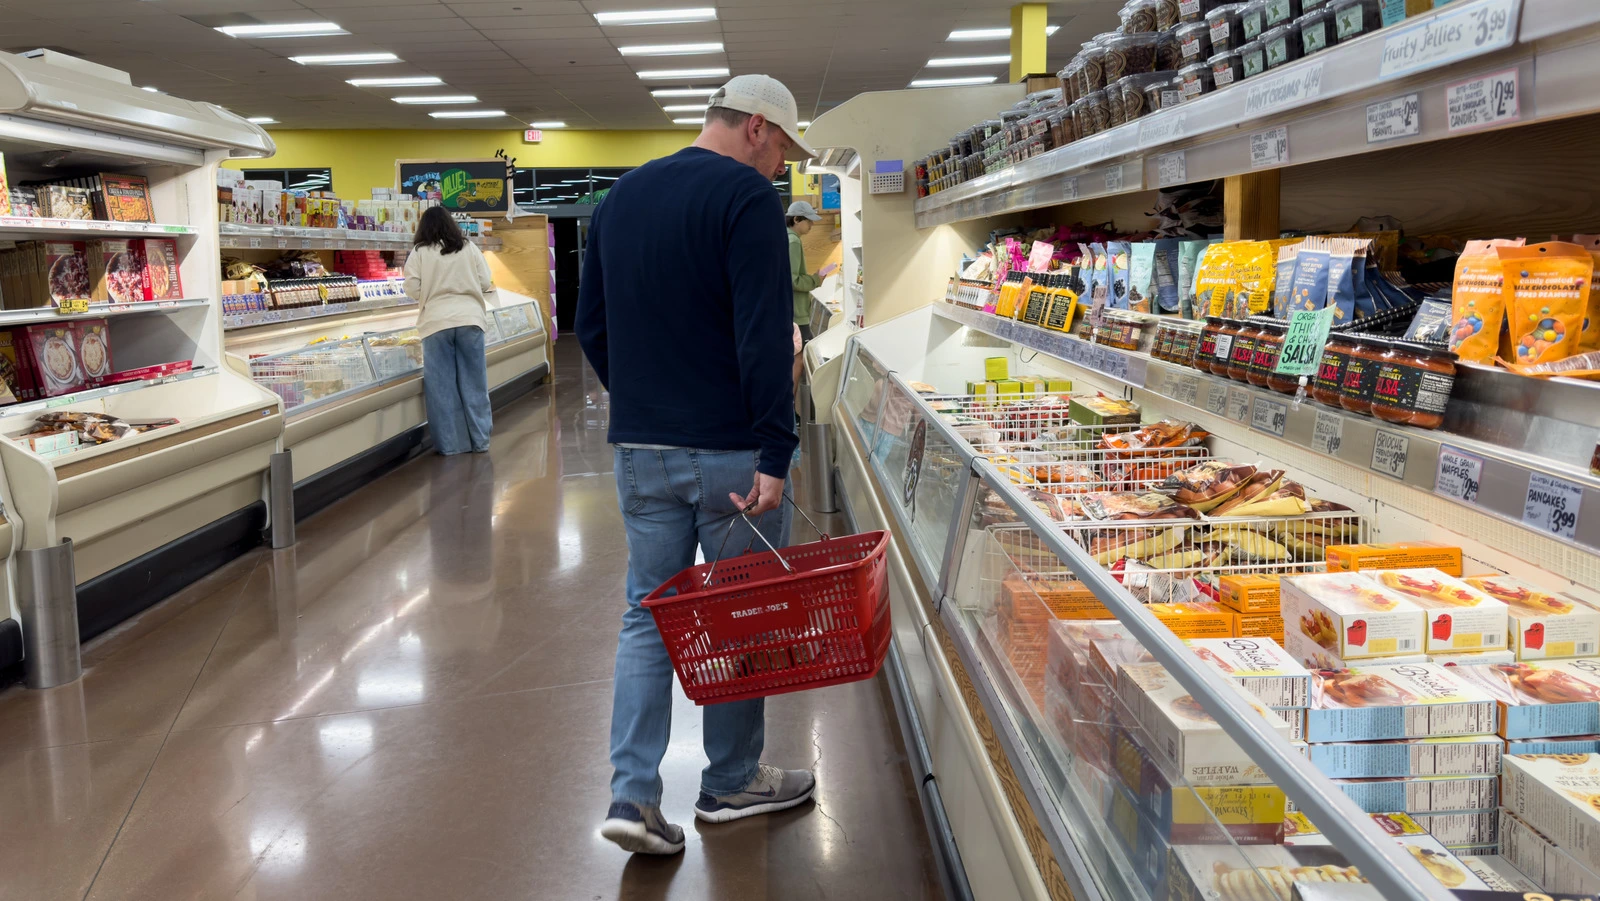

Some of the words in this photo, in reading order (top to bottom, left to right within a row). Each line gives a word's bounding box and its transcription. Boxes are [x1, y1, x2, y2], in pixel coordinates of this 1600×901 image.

[1383, 38, 1417, 62] Fruity
[1420, 23, 1463, 52] Jellies
[1475, 7, 1506, 46] 3.99
[1495, 80, 1515, 116] 2.99
[1450, 109, 1478, 127] CANDIES
[527, 130, 541, 141] EXIT
[1372, 125, 1393, 138] PEANUTS
[441, 171, 466, 200] VALUE!
[1538, 291, 1581, 299] PEANUTS
[1281, 345, 1318, 364] SALSA
[1316, 422, 1338, 435] BELGIAN
[1376, 433, 1404, 451] BRIOCHE
[1375, 448, 1394, 458] FRENCH
[1375, 455, 1388, 464] TOAST
[1443, 454, 1457, 465] WHOLE
[1459, 459, 1476, 468] GRAIN
[1441, 463, 1469, 480] WAFFLES
[1532, 474, 1549, 484] GLUTEN
[1527, 489, 1567, 510] PANCAKES
[1552, 508, 1576, 533] 3.99
[731, 607, 763, 619] TRADER
[765, 602, 789, 613] JOE'S
[1390, 665, 1459, 699] Brioche
[1192, 765, 1239, 775] WAFFLES
[1214, 806, 1248, 818] PANCAKES
